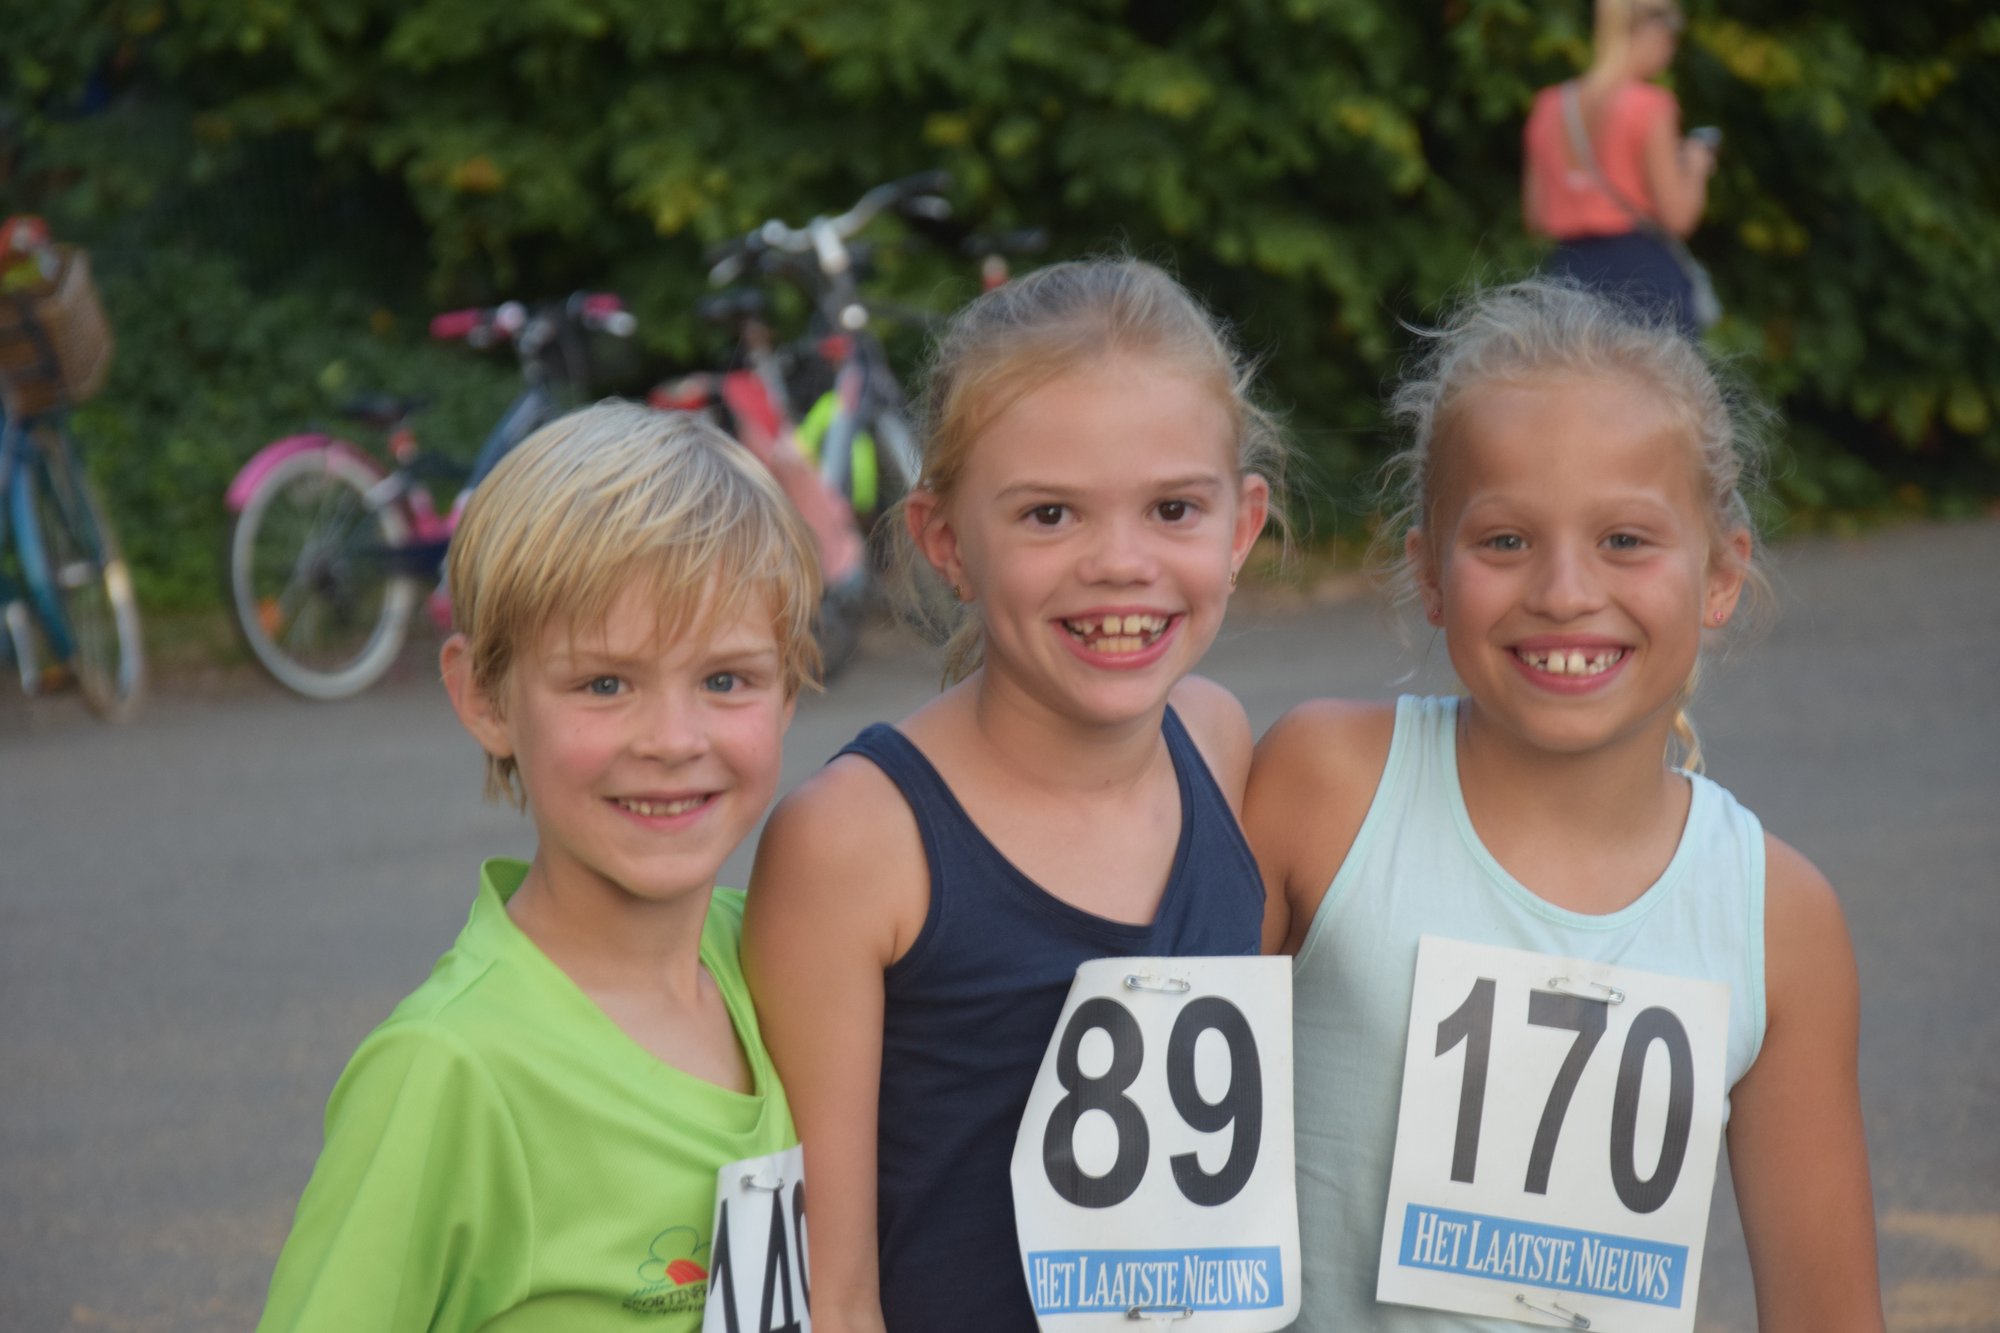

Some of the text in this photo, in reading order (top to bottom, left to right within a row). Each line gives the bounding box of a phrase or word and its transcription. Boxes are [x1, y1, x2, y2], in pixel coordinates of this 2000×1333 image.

[1042, 995, 1263, 1209] 89
[1434, 976, 1695, 1215] 170
[709, 1178, 812, 1333] 14
[1034, 1255, 1270, 1309] HET LAATSTE NIEUWS
[1411, 1211, 1673, 1301] HET LAATSTE NIEUWS
